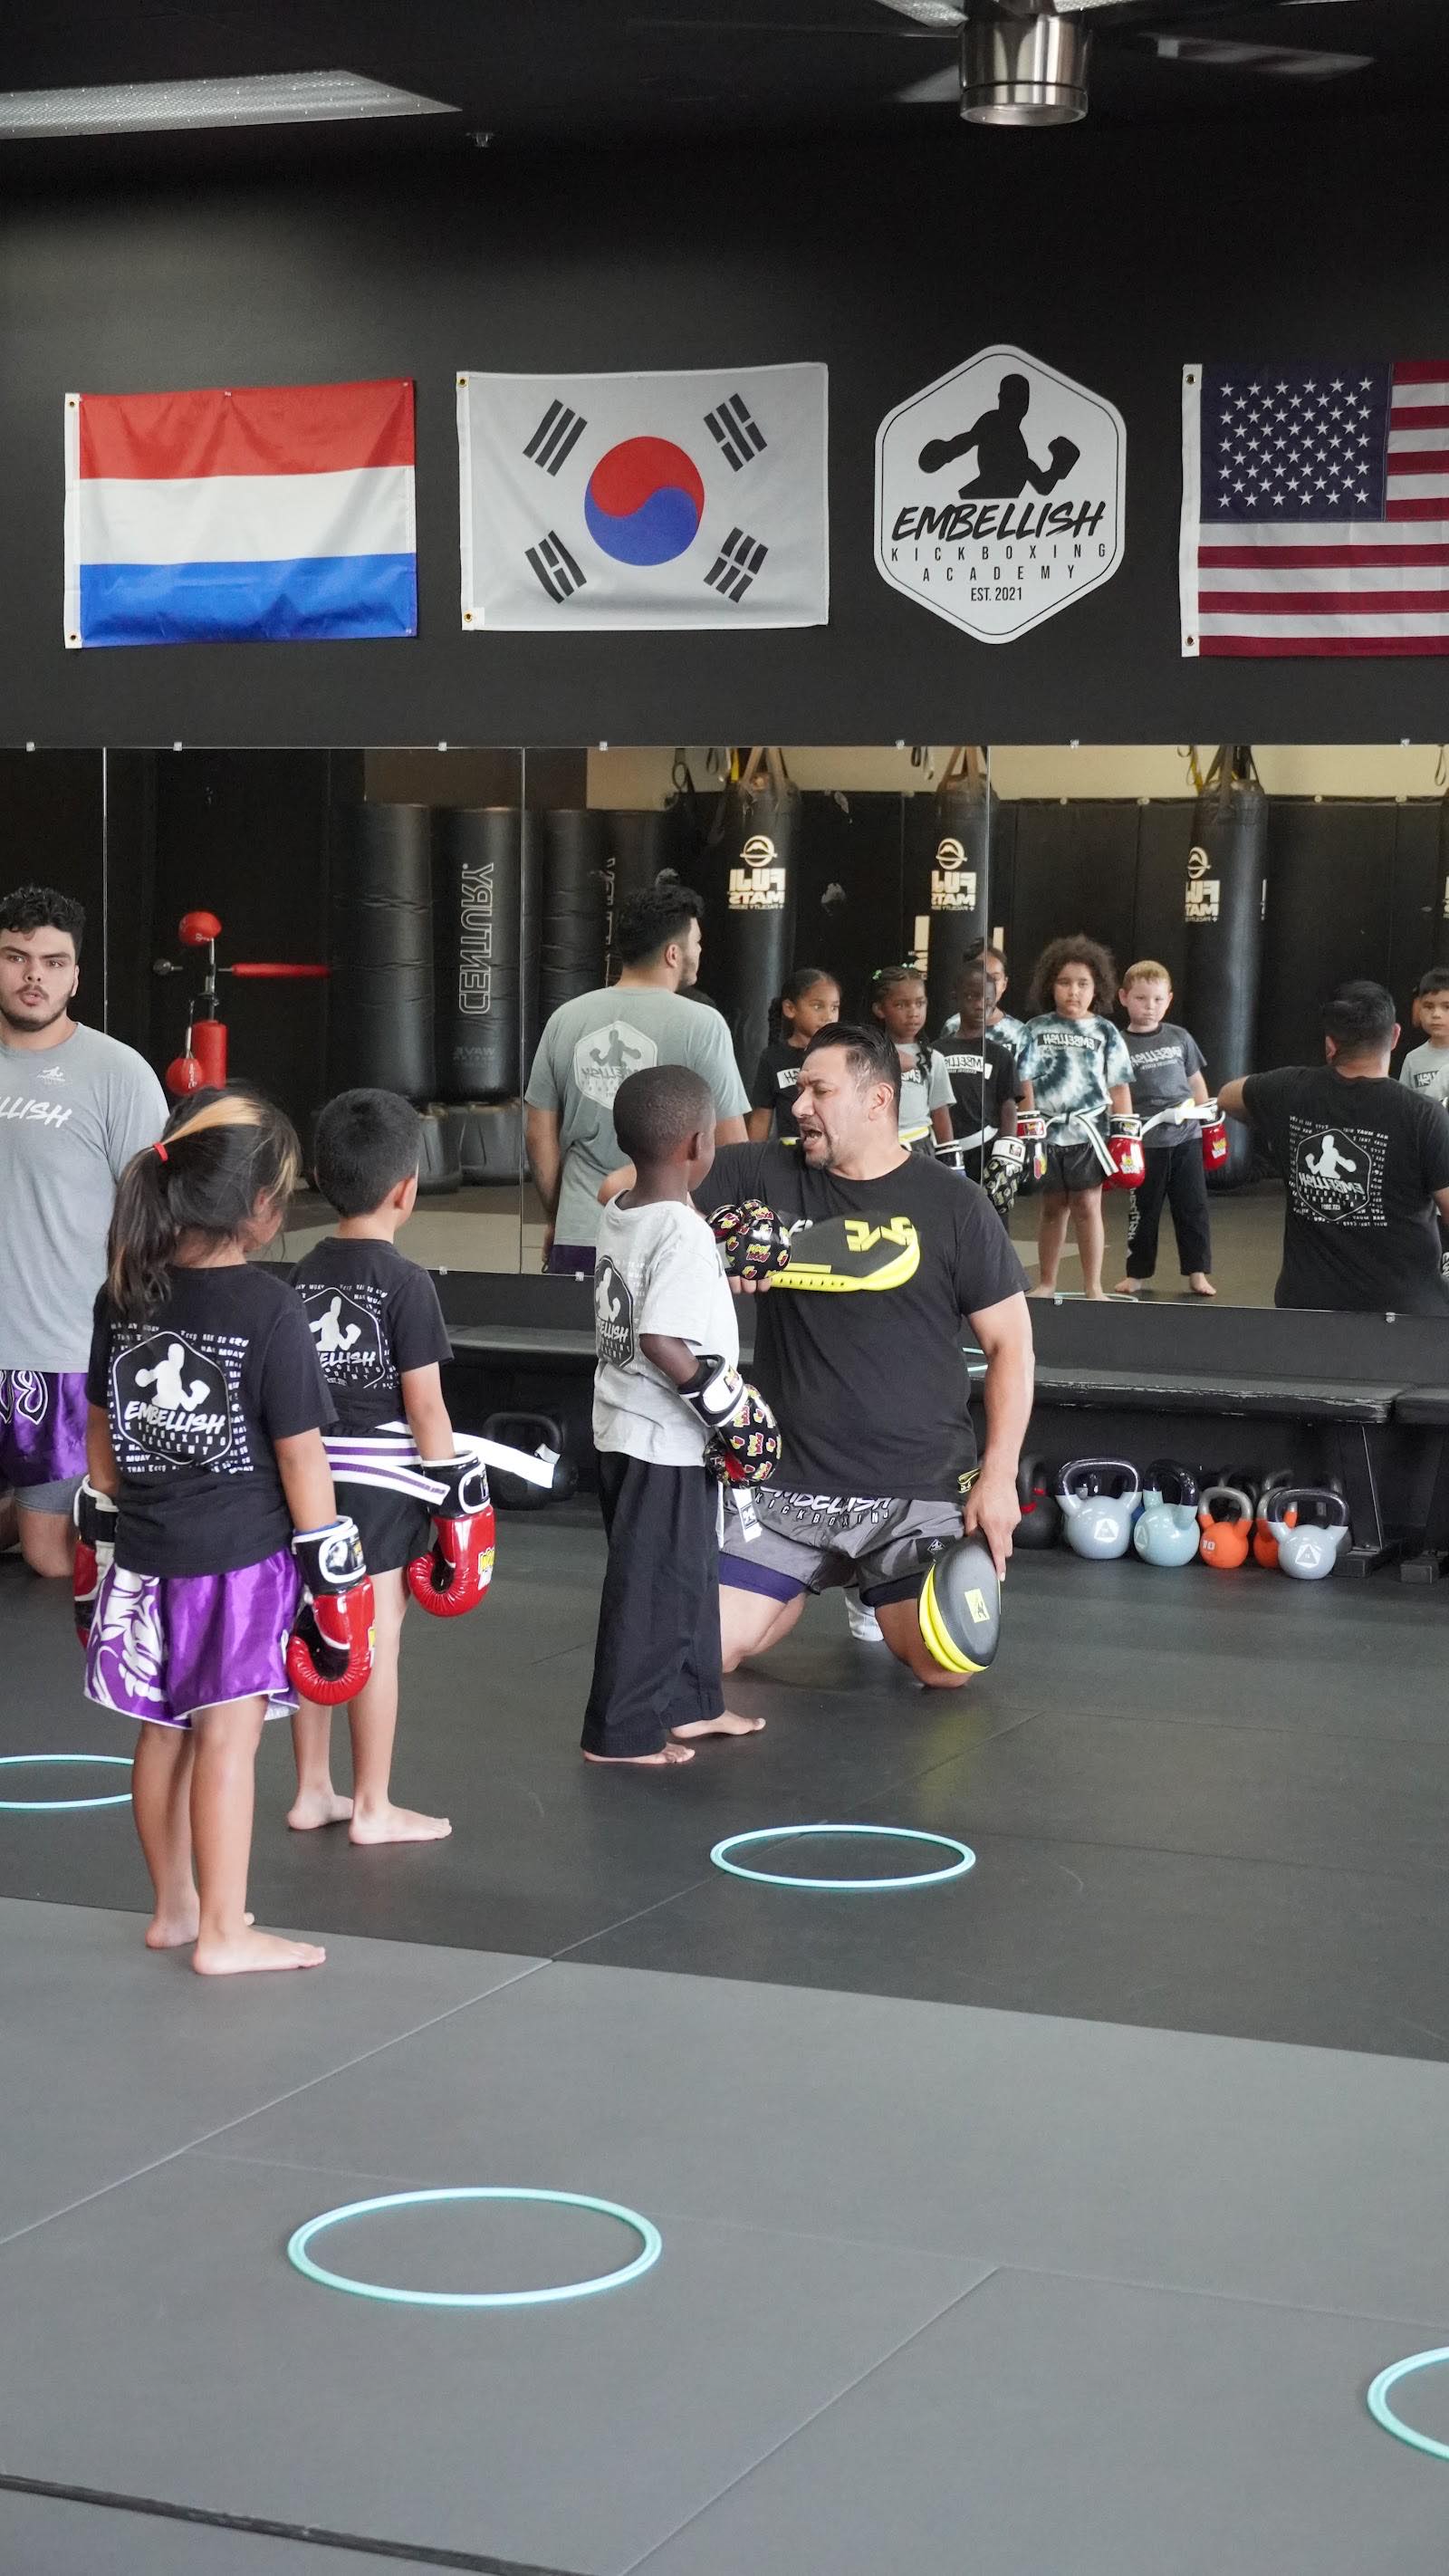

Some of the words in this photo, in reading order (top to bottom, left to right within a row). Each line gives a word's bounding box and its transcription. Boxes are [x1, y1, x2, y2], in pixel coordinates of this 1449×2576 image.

[891, 500, 1106, 542] EMBELLISH
[891, 543, 1106, 562] KICKBOXING
[923, 565, 1075, 582] ACADEMY
[971, 587, 992, 601] EST.
[995, 587, 1022, 601] 2021
[0, 1096, 72, 1128] LLISH
[319, 1351, 376, 1368] ELLISH
[124, 1401, 226, 1434] EMBELLISH
